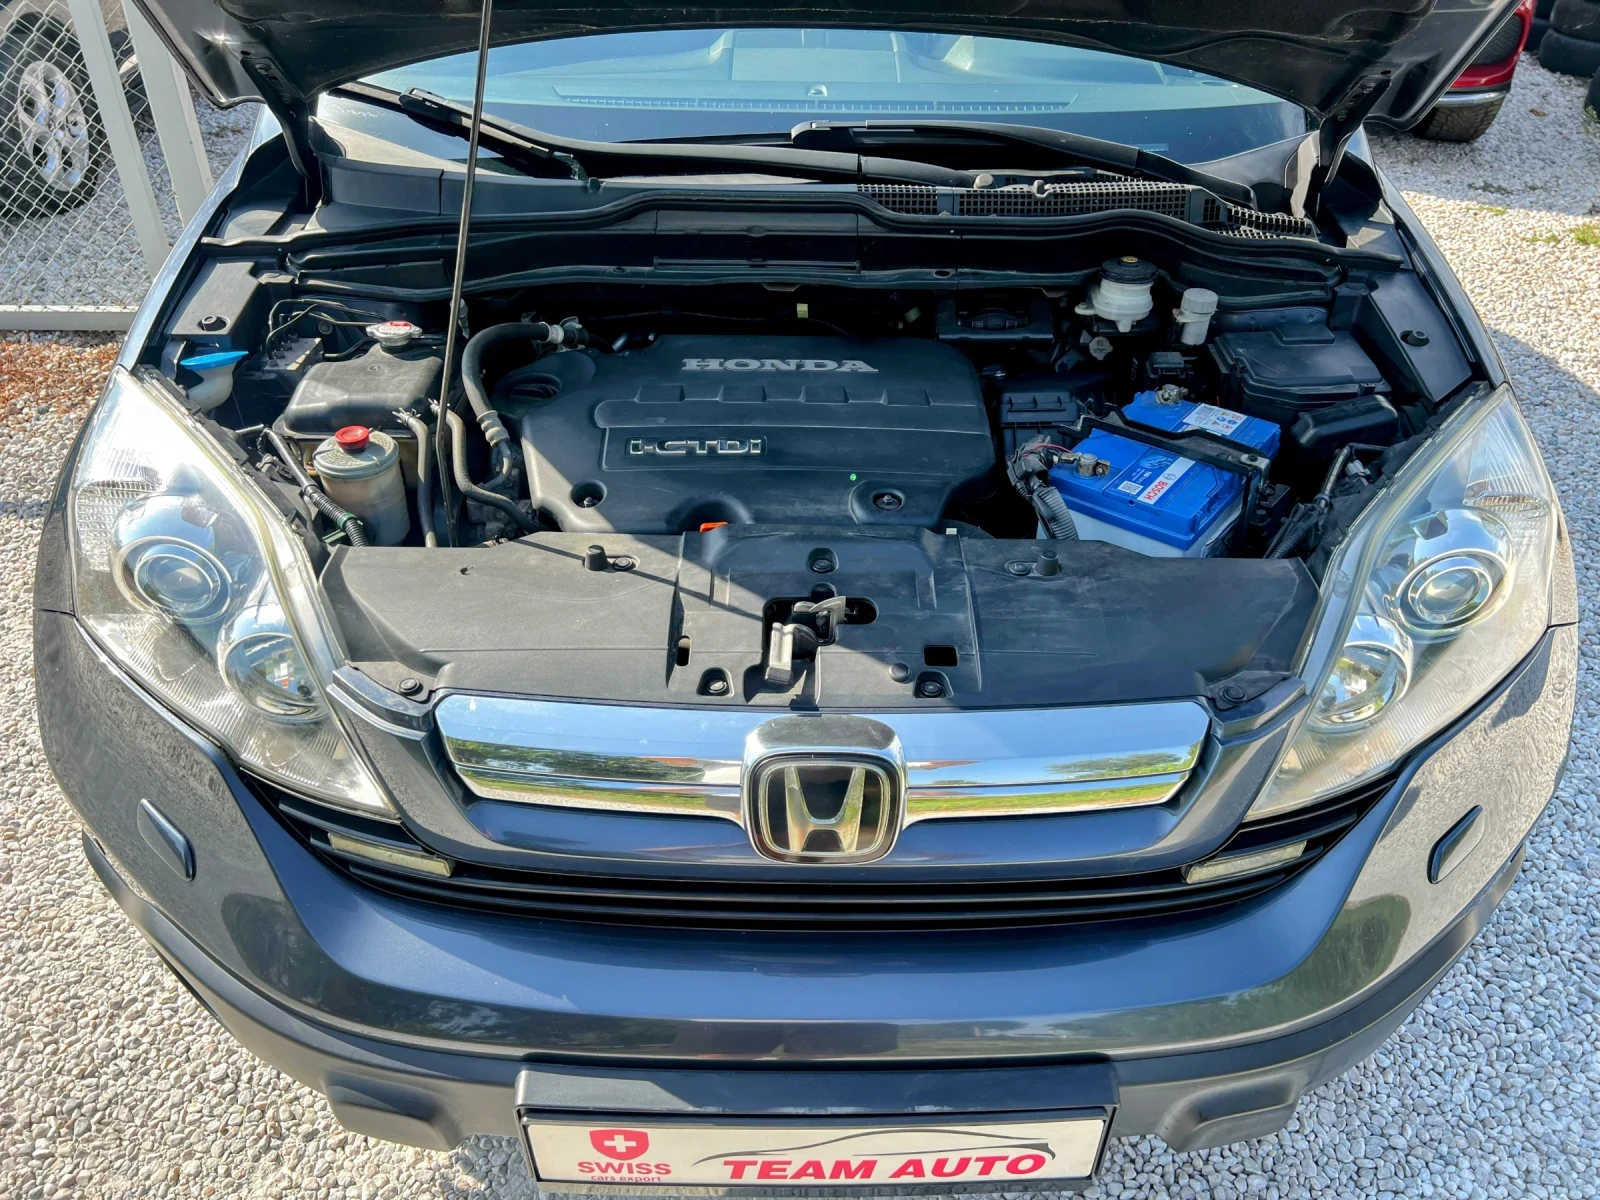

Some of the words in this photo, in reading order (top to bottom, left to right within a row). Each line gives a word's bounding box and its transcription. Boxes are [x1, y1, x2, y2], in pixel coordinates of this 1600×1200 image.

[681, 358, 879, 373] HONDA
[1143, 480, 1168, 501] BOSCH
[577, 1161, 672, 1175] SWISS
[723, 1159, 878, 1180] TEAM
[888, 1153, 1047, 1179] AUTO
[619, 1175, 662, 1183] export
